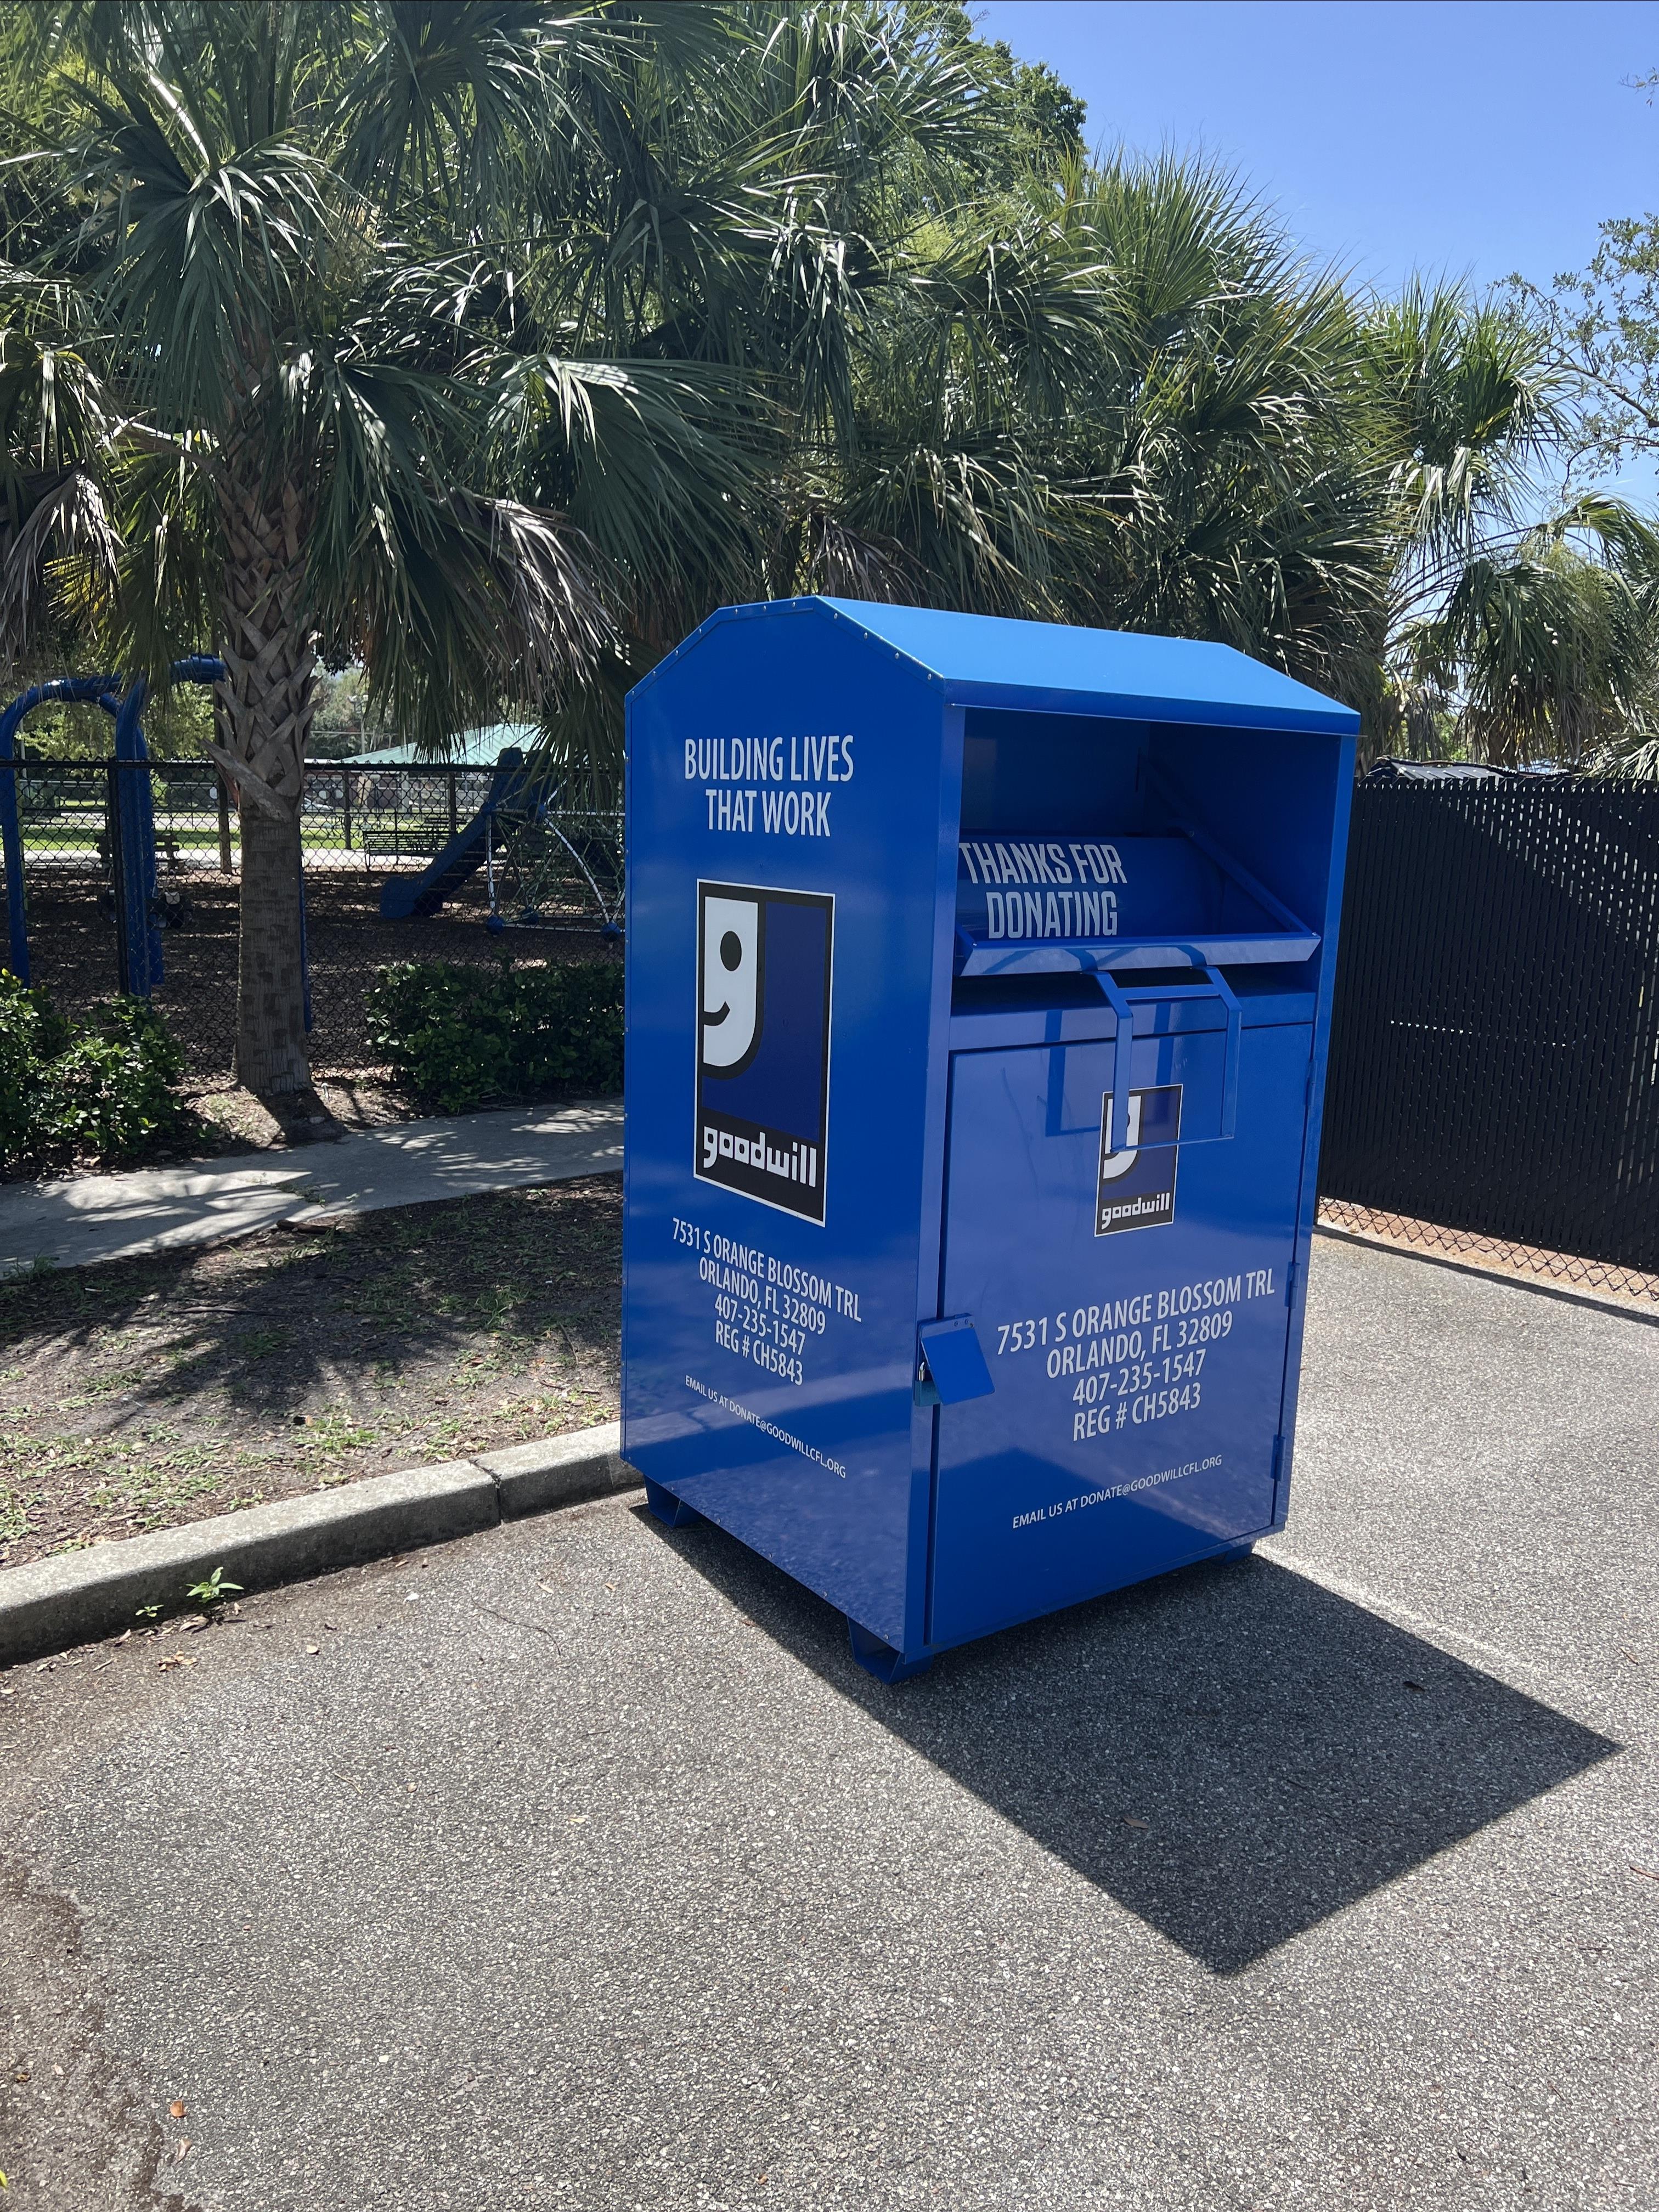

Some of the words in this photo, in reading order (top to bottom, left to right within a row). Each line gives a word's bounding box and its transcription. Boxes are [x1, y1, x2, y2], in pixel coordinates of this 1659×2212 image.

[685, 737, 783, 781] BUILDING
[791, 735, 854, 782] LIVES
[706, 789, 757, 833] THAT
[761, 790, 832, 837] WORK
[959, 843, 1073, 884] THANKS
[1069, 844, 1127, 884] FOR
[986, 891, 1118, 939] DONATING
[703, 1126, 817, 1188] goodwill
[1101, 1193, 1170, 1230] goodwill
[673, 1217, 700, 1250] 7531
[703, 1231, 711, 1254] S
[713, 1234, 765, 1278] ORANGE
[768, 1257, 832, 1308] BLOSSOM
[835, 1285, 862, 1322] TRL
[699, 1257, 761, 1310] ORLANDO,
[765, 1285, 780, 1315] FL
[783, 1295, 826, 1335] 32809
[714, 1293, 806, 1356] 407-235-1547
[997, 1317, 1047, 1355] 7531
[1055, 1312, 1067, 1342] S
[1072, 1294, 1153, 1338] ORANGE
[1157, 1276, 1241, 1319] BLOSSOM
[1245, 1268, 1275, 1299] TRL
[715, 1319, 739, 1353] REG
[742, 1334, 751, 1358] #
[753, 1339, 803, 1386] CH5843
[1047, 1330, 1146, 1379] ORLANDO,
[1152, 1324, 1172, 1354] FL
[1176, 1310, 1233, 1348] 32809
[1073, 1348, 1206, 1406] 407-235-1547
[685, 1375, 707, 1397] EMAIL
[708, 1387, 718, 1402] US
[719, 1395, 729, 1408] AT
[729, 1400, 846, 1479] DONATE@GOODWILLCFL.ORG
[1073, 1404, 1110, 1442] REG
[1115, 1401, 1127, 1430] #
[1132, 1382, 1201, 1424] CH5843
[1013, 1508, 1046, 1529] EMAIL
[1048, 1502, 1063, 1517] US
[1064, 1497, 1079, 1513] AT
[1080, 1454, 1222, 1508] DONATE@GOODWILLCFL.ORG
